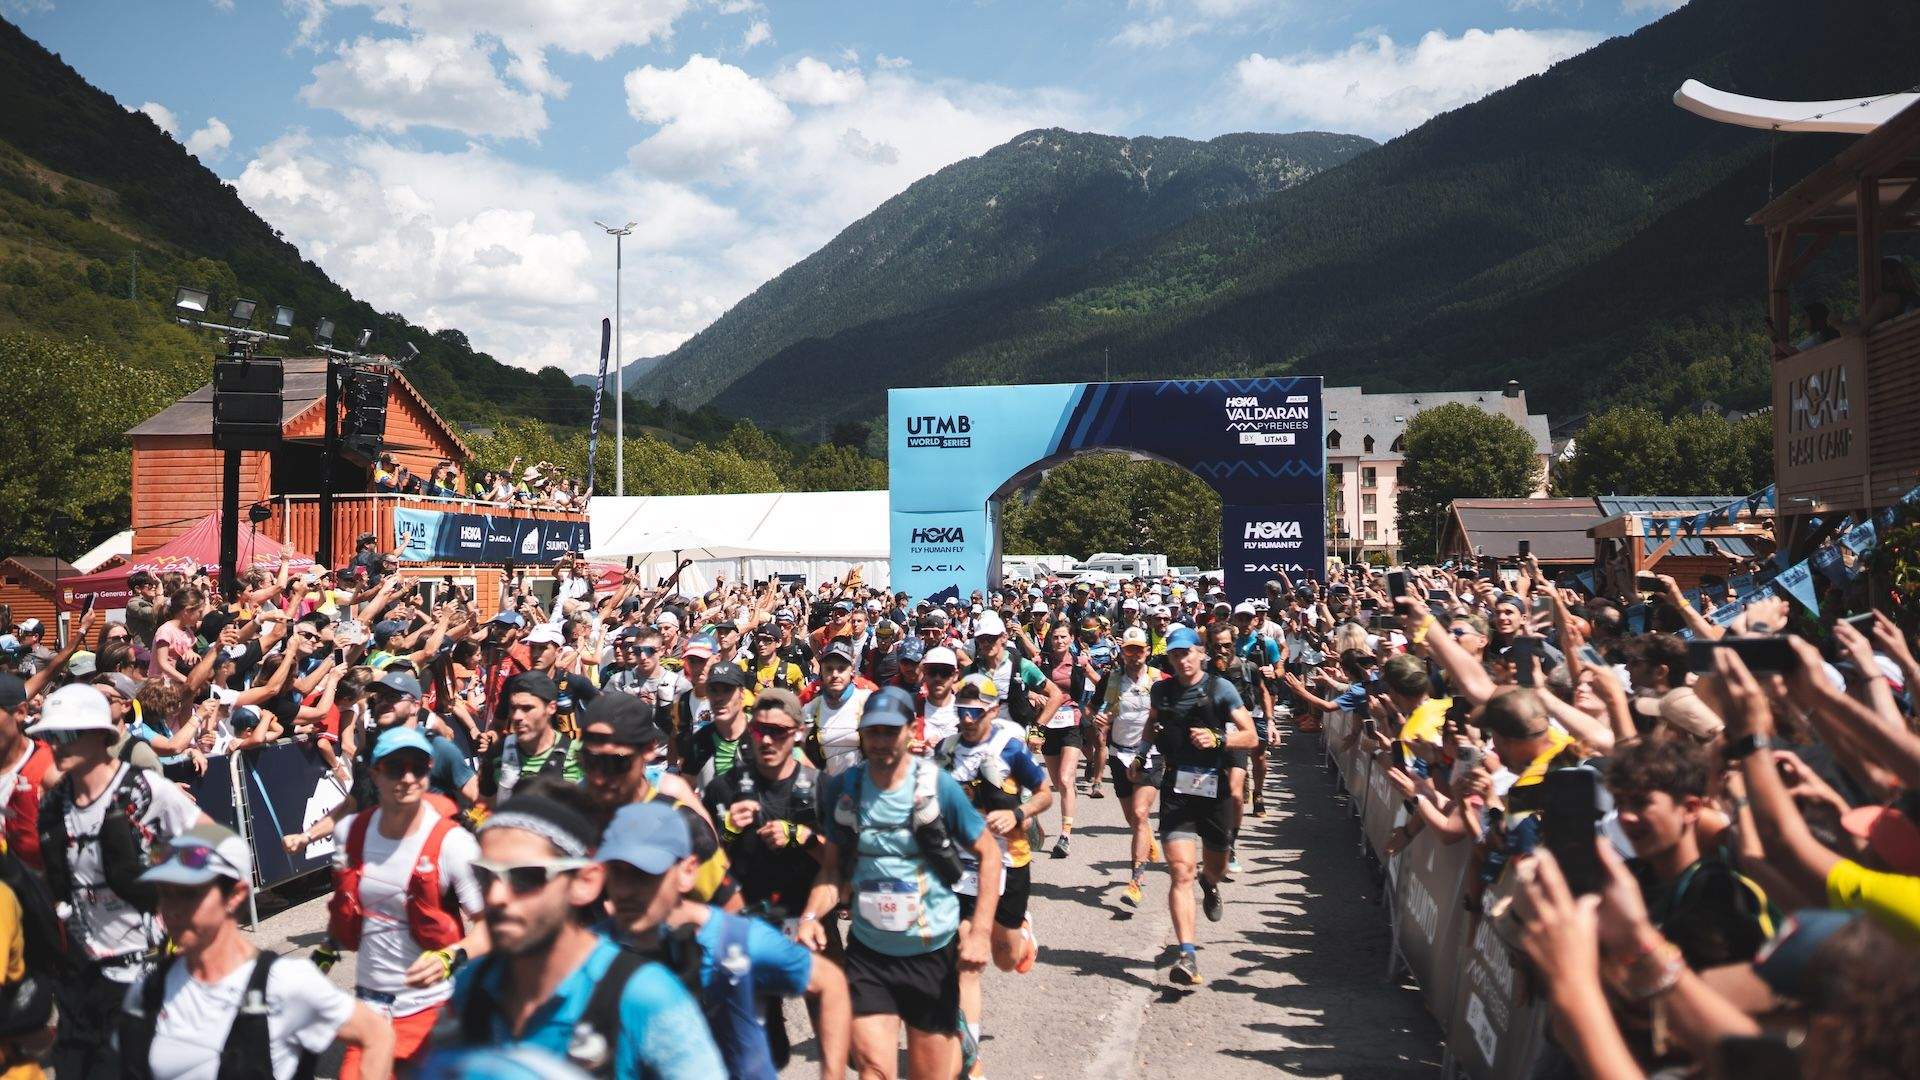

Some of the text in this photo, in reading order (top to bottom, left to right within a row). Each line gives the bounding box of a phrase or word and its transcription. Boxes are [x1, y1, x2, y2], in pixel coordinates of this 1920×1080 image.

[1225, 396, 1259, 408] HOKA
[1788, 364, 1849, 434] HOKA
[907, 415, 971, 435] UTMB
[1257, 421, 1309, 430] PYRENEES
[909, 438, 969, 447] WORLD SERIES
[1264, 435, 1288, 443] UTMB
[461, 526, 481, 540] HOKA
[911, 527, 965, 543] HOKA
[1244, 521, 1303, 539] HOKA
[546, 540, 569, 551] SUUNTO
[1244, 541, 1303, 549] FLY HUMAN FLY
[911, 564, 966, 572] DACIA
[100, 589, 127, 598] Generau
[878, 902, 897, 913] 168
